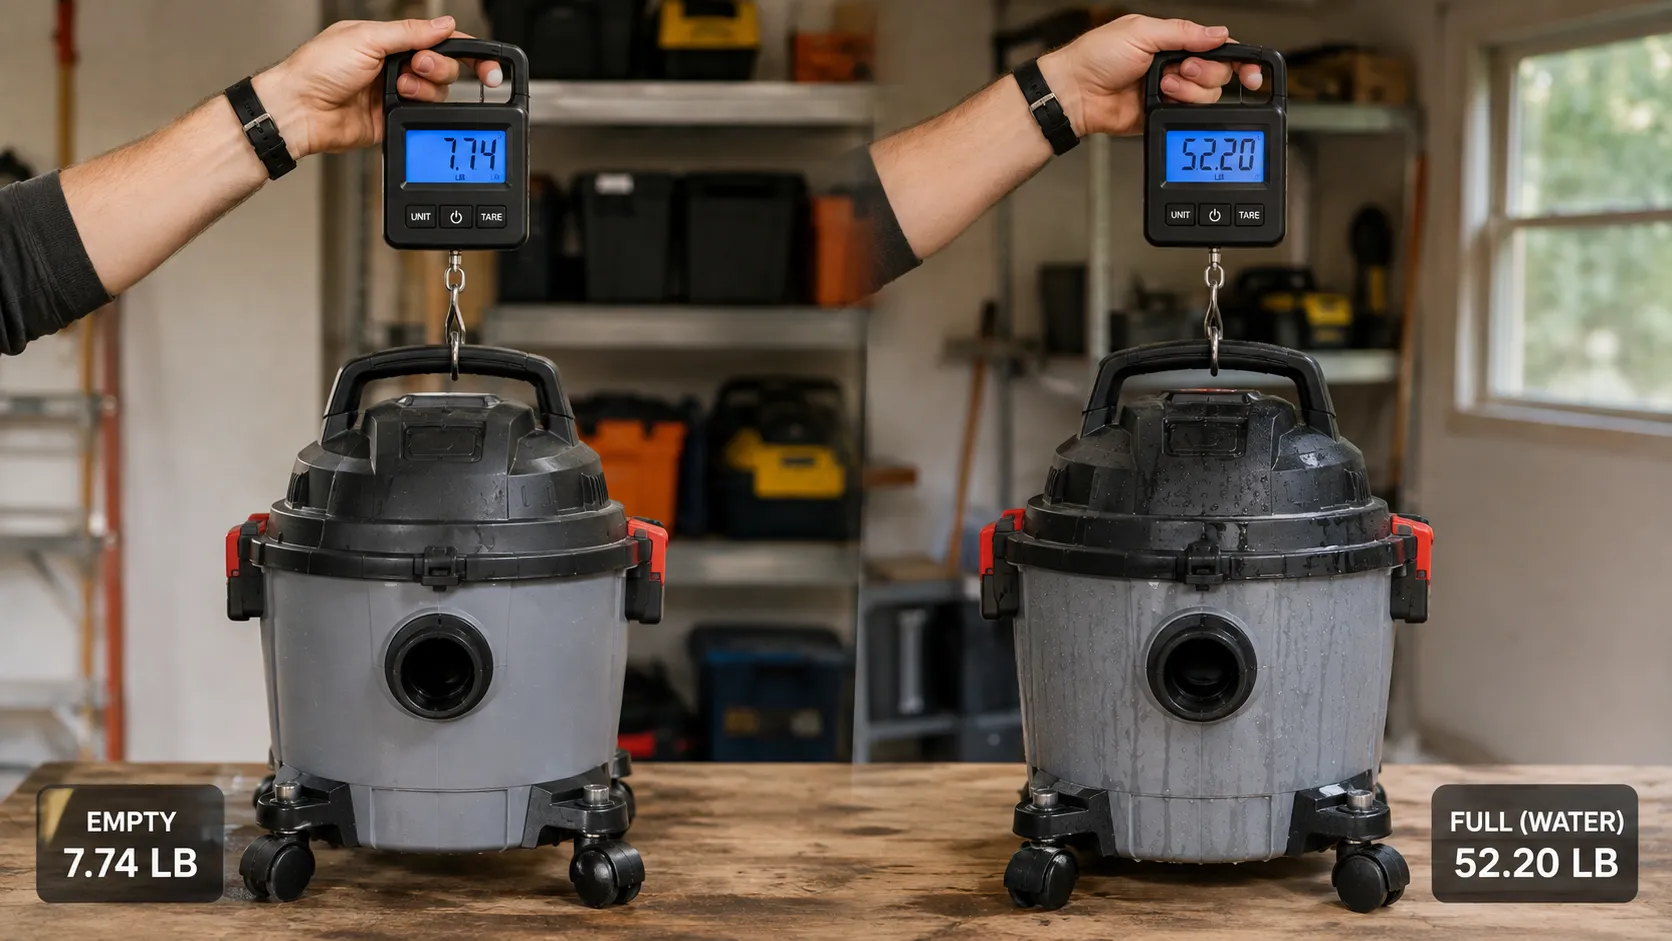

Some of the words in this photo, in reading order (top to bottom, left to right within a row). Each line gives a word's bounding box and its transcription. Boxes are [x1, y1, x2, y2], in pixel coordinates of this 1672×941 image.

[443, 137, 497, 171] 7.74
[1181, 138, 1256, 171] 52.20
[410, 212, 431, 221] UNIT
[480, 212, 503, 221] TARE
[1170, 210, 1191, 219] UNIT
[1238, 210, 1260, 219] TARE
